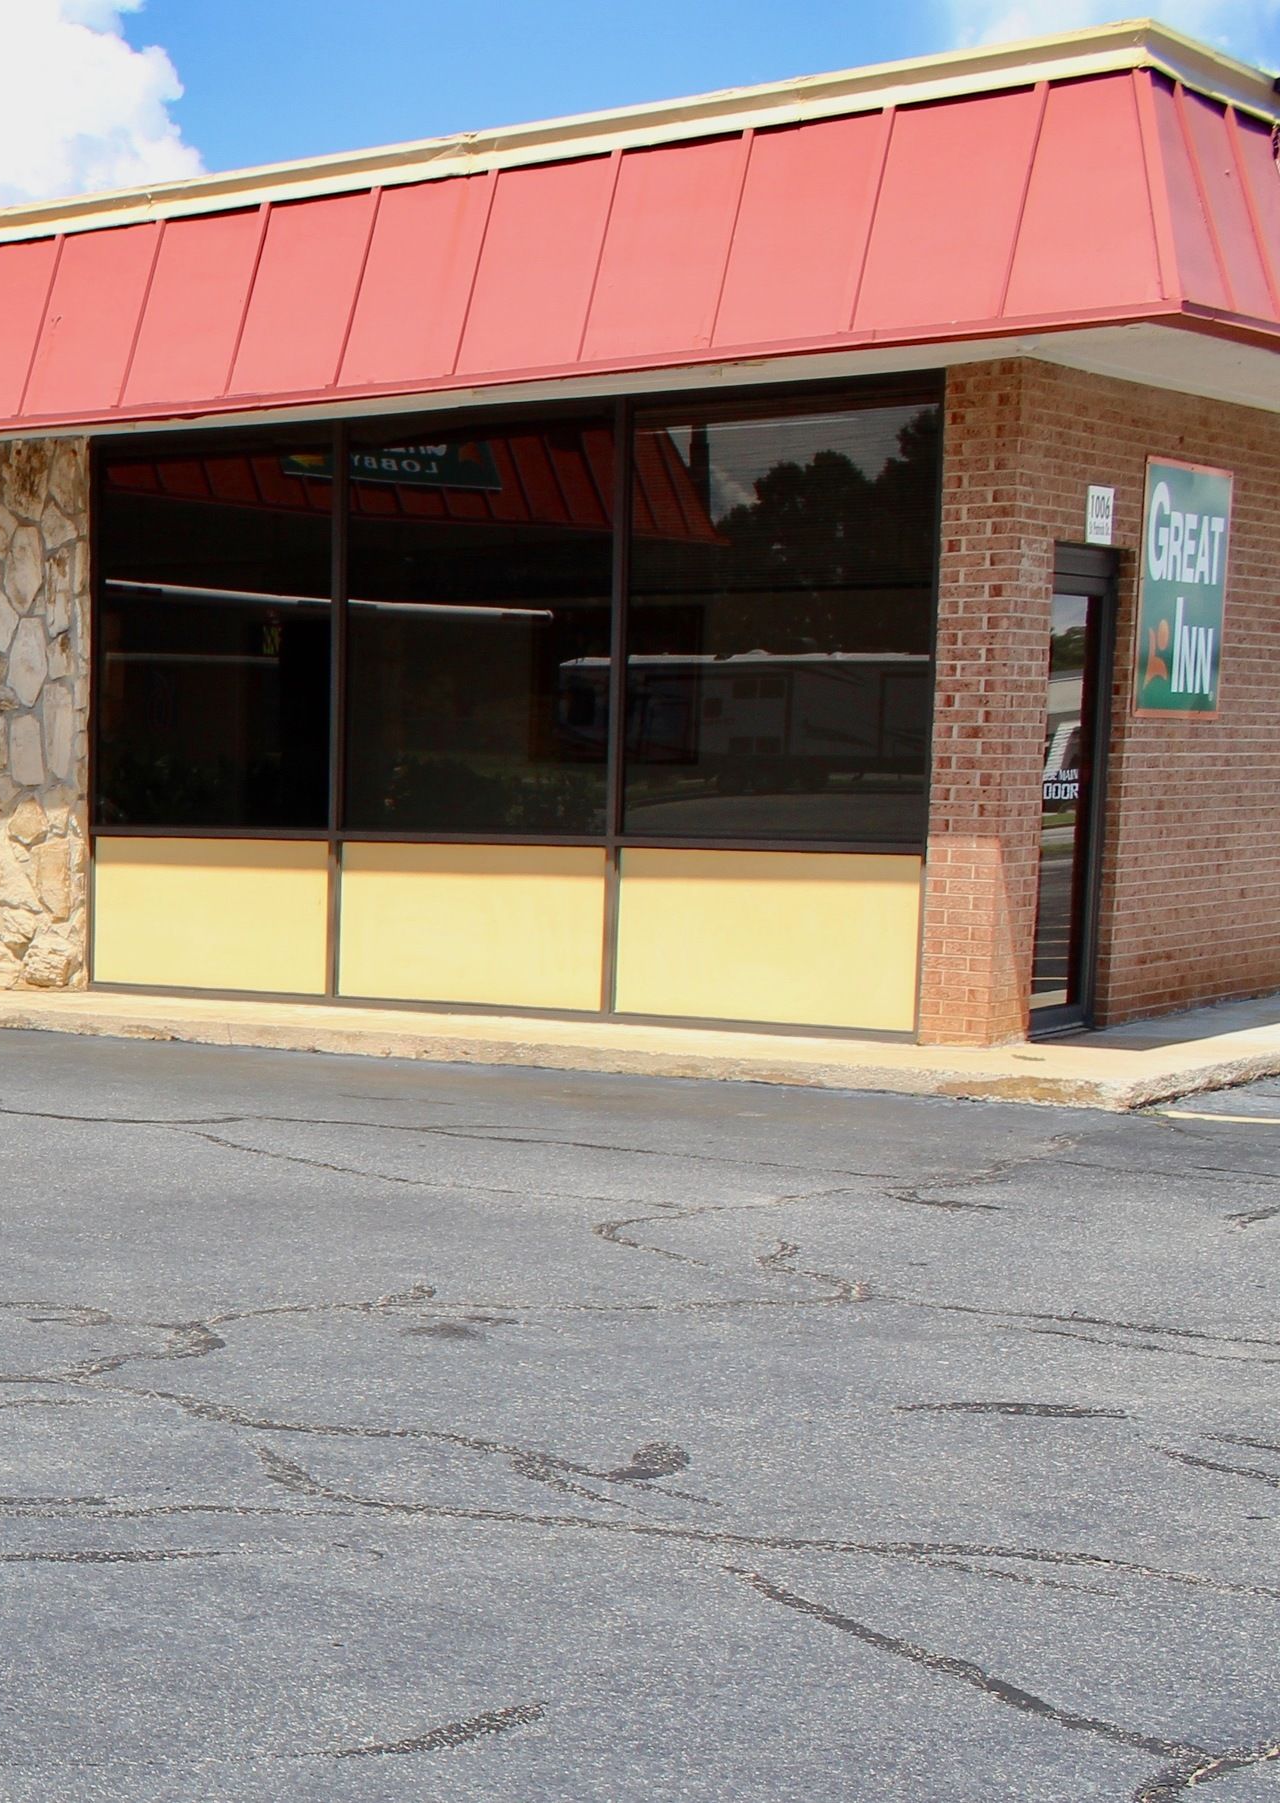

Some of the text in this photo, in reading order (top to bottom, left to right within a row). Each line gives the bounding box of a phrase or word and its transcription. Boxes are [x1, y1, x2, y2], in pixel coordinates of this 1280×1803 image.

[1091, 494, 1111, 519] 1006
[1148, 481, 1225, 586] GREAT
[1171, 596, 1214, 695] INN
[1043, 783, 1079, 800] DOOR
